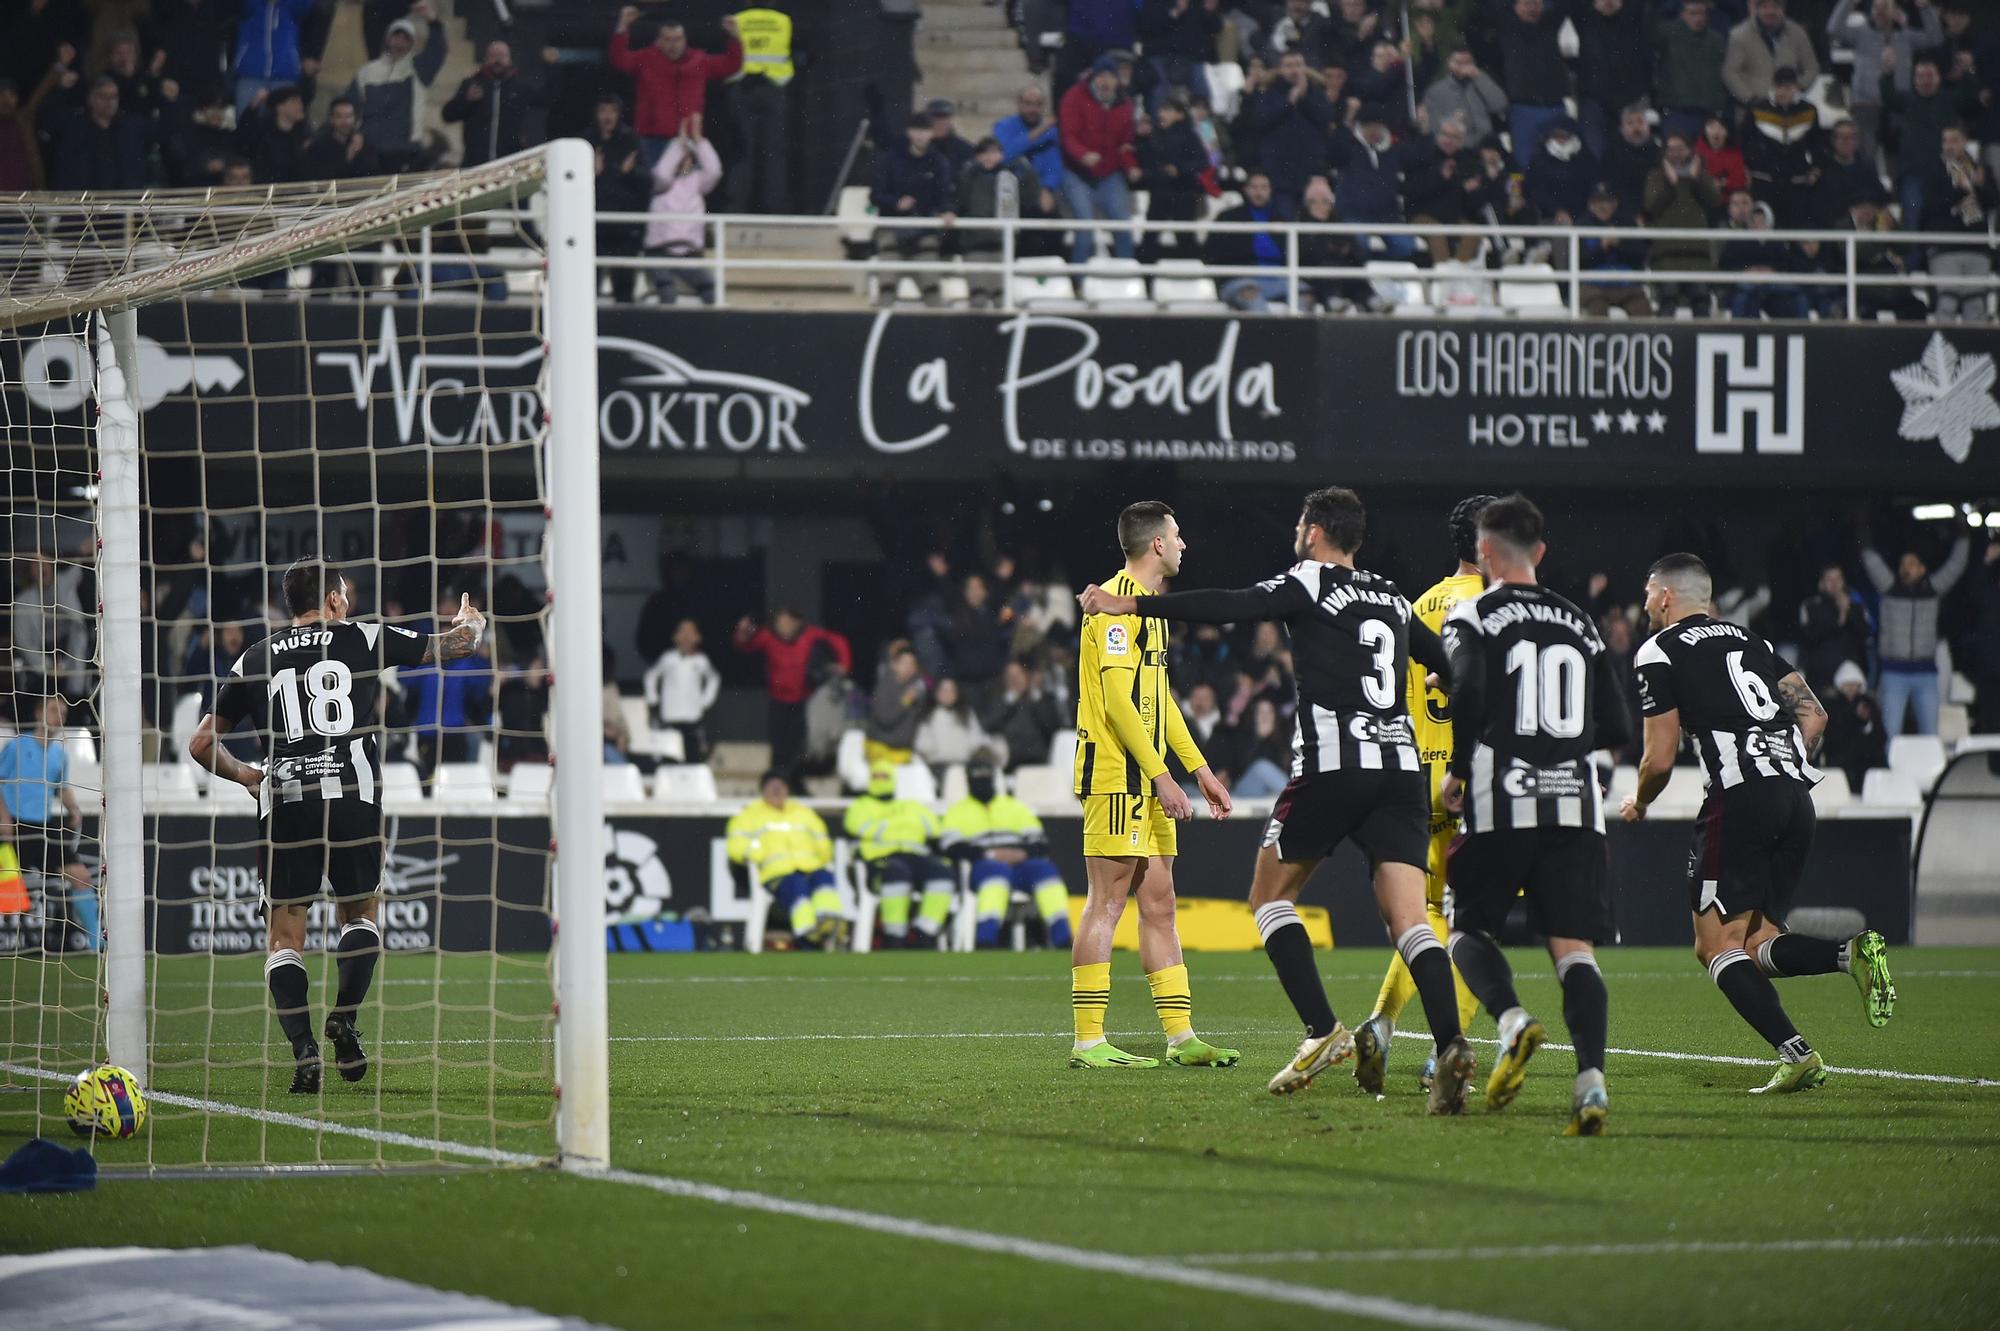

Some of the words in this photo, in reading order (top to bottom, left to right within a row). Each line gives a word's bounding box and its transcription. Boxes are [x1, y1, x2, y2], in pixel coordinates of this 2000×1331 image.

[860, 310, 955, 452] La
[998, 313, 1281, 452] Posada
[1397, 330, 1460, 397] LOS
[1469, 331, 1673, 400] HABANEROS
[420, 377, 807, 453] CAROKTOR
[1032, 438, 1069, 461] DE
[1074, 439, 1125, 461] LOS
[1133, 440, 1296, 463] HABANEROS
[1468, 413, 1588, 447] HOTEL
[271, 631, 334, 655] MUSTO
[1358, 618, 1396, 709] 3
[267, 659, 355, 744] 18
[1505, 639, 1587, 739] 10
[1726, 650, 1780, 722] 6
[1131, 795, 1144, 820] 2
